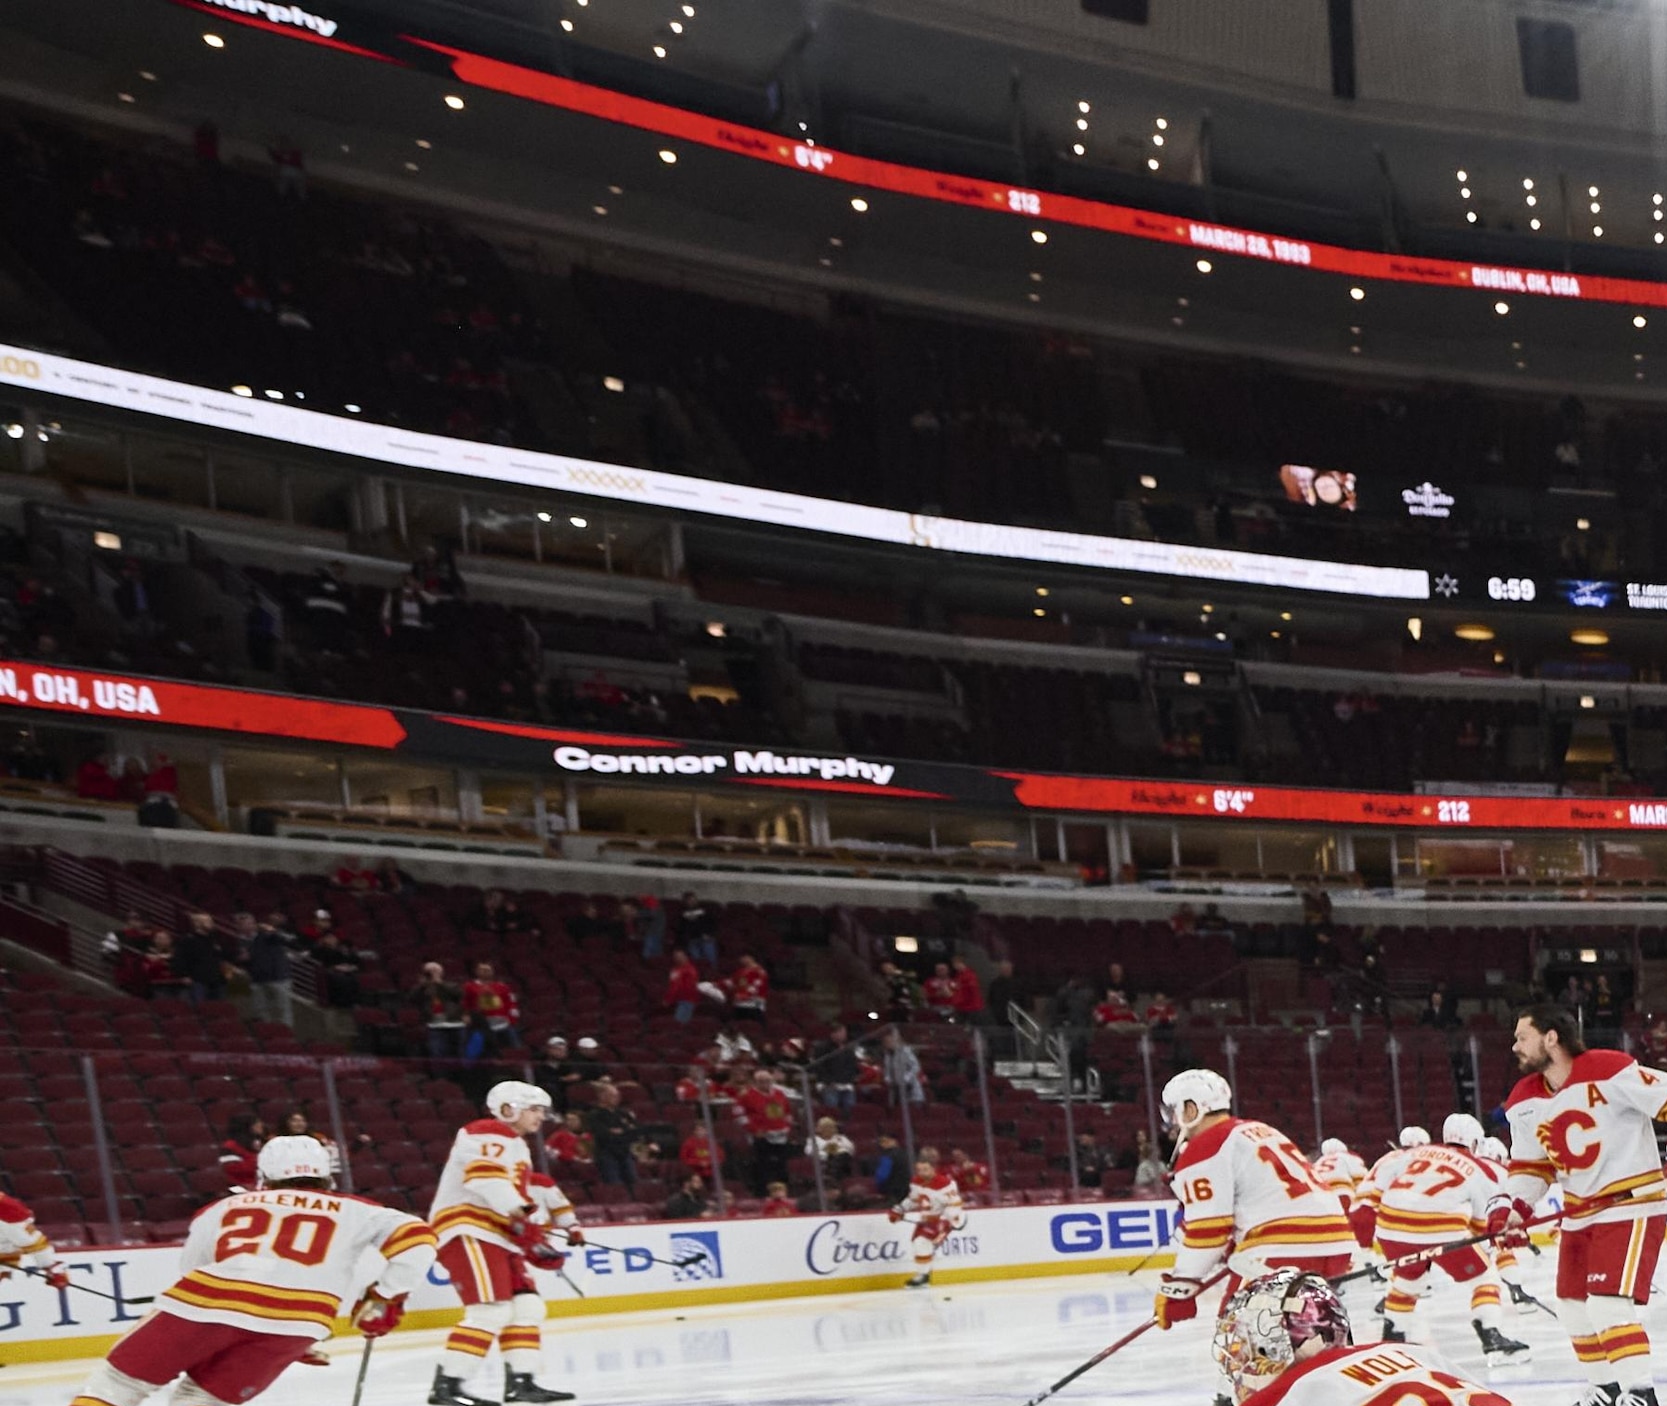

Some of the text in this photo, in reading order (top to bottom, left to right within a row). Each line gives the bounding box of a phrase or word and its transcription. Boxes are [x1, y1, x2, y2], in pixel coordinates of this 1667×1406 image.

[1487, 576, 1536, 601] 6:59
[32, 672, 90, 710] OH,
[93, 679, 161, 716] USA
[553, 746, 895, 785] Connor Murphy
[1437, 800, 1472, 823] 212
[1586, 1081, 1609, 1108] A
[480, 1142, 505, 1159] 17
[1183, 1177, 1214, 1204] 16
[1389, 1160, 1466, 1197] 27
[214, 1206, 338, 1267] 20
[806, 1219, 905, 1276] Circa
[1049, 1208, 1184, 1254] GEI
